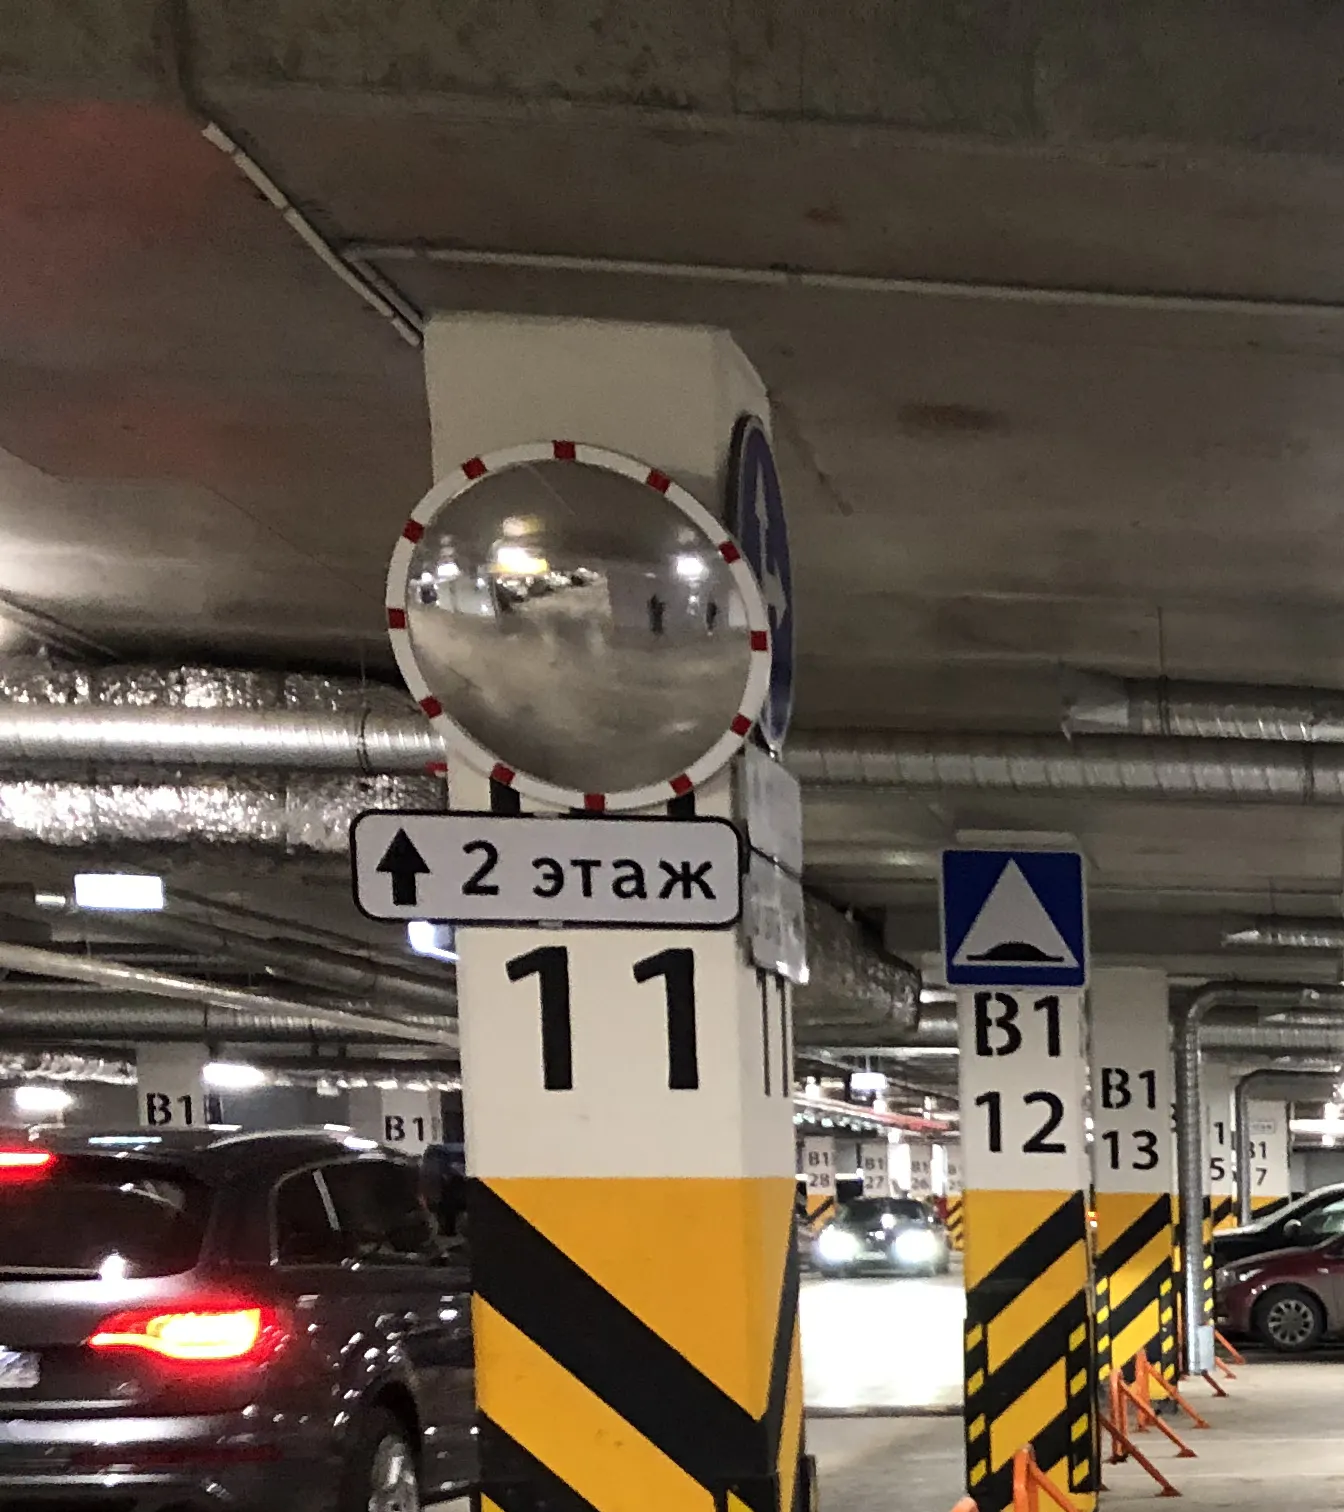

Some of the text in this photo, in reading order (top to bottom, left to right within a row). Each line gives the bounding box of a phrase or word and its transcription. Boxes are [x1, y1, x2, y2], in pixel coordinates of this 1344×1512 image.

[462, 839, 717, 899] 2 этаж
[505, 946, 698, 1090] 11
[974, 991, 1060, 1058] B1
[147, 1092, 193, 1126] B1
[1102, 1067, 1157, 1109] B1
[384, 1115, 424, 1142] B1
[974, 1091, 1066, 1154] 12
[1102, 1130, 1159, 1170] 13
[1209, 1157, 1226, 1181] 5
